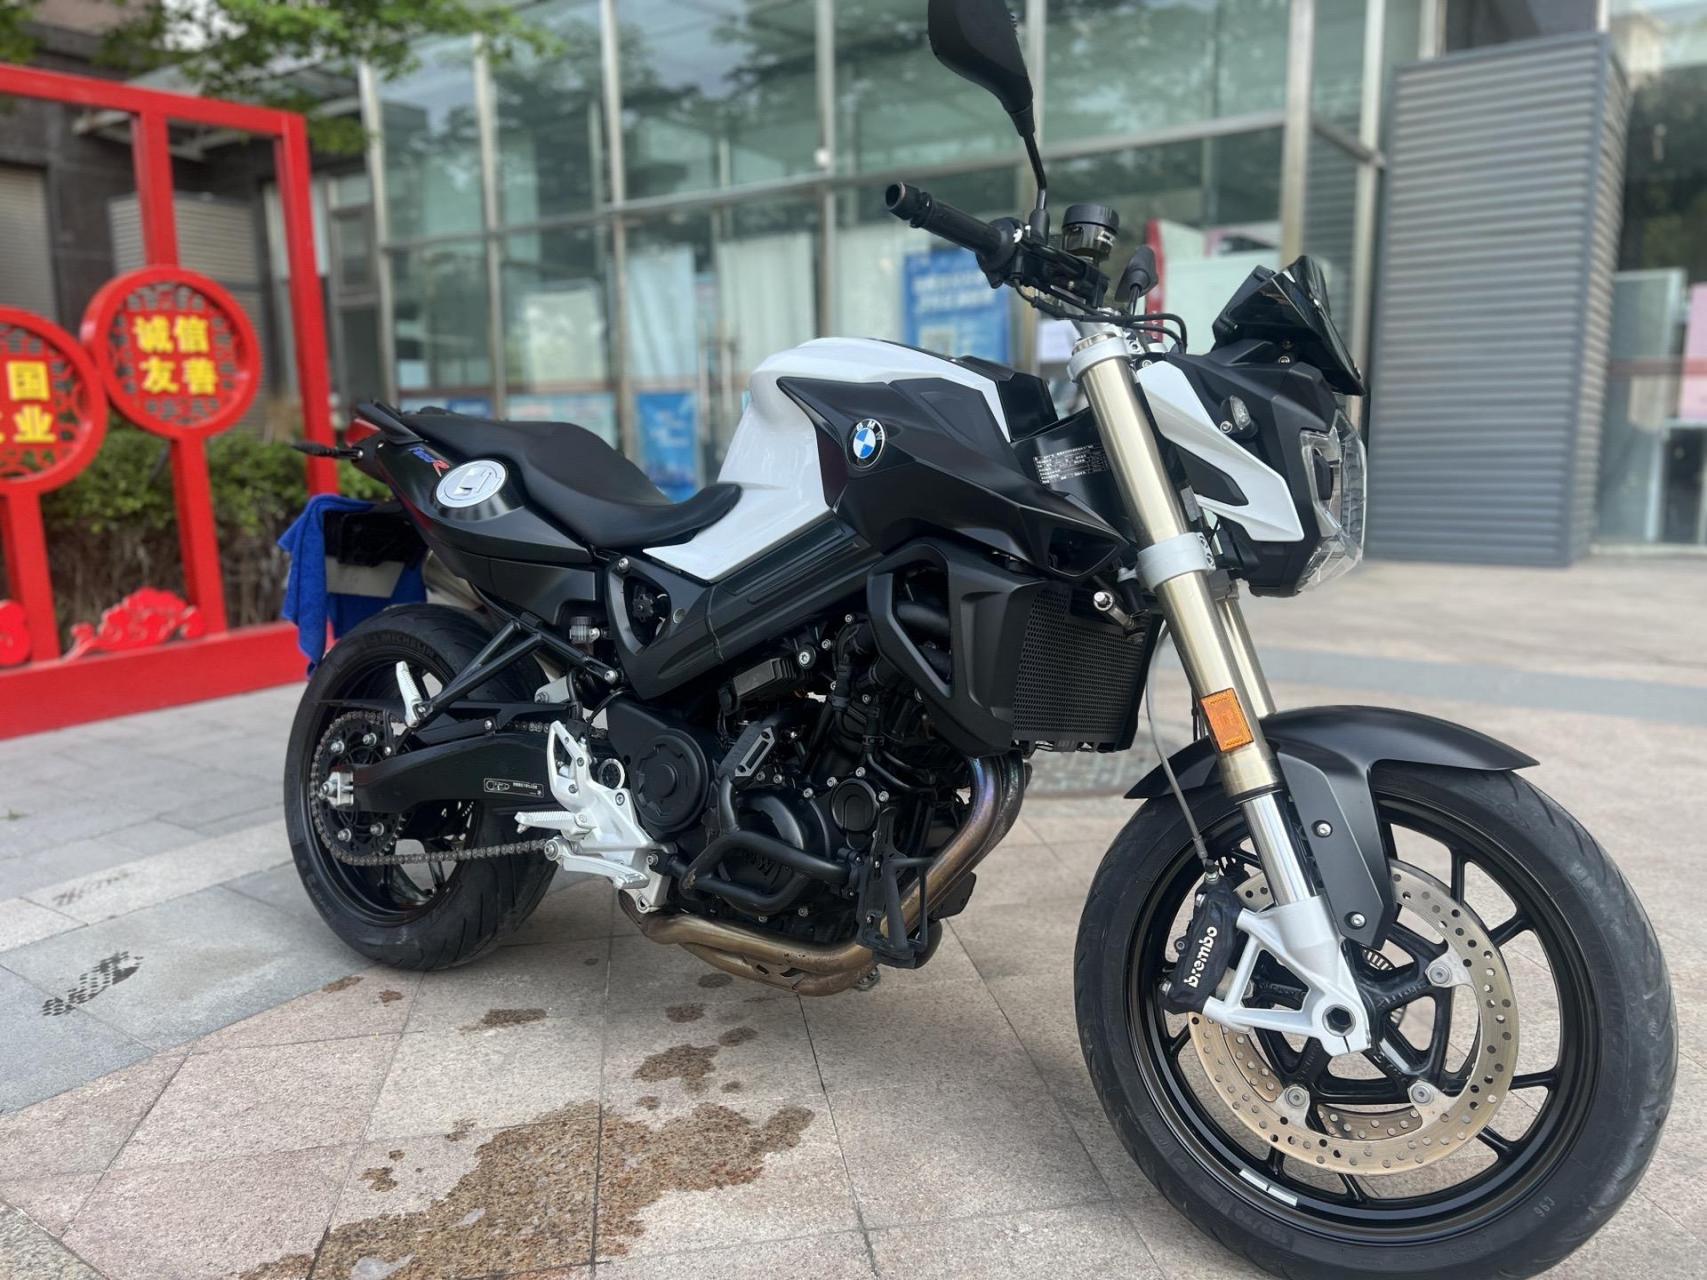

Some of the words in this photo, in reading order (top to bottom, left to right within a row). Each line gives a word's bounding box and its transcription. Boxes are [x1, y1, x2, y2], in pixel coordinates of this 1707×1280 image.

[132, 315, 210, 353] 诚信
[139, 356, 218, 395] 友善
[855, 420, 883, 441] BMW
[1183, 926, 1218, 988] brembo
